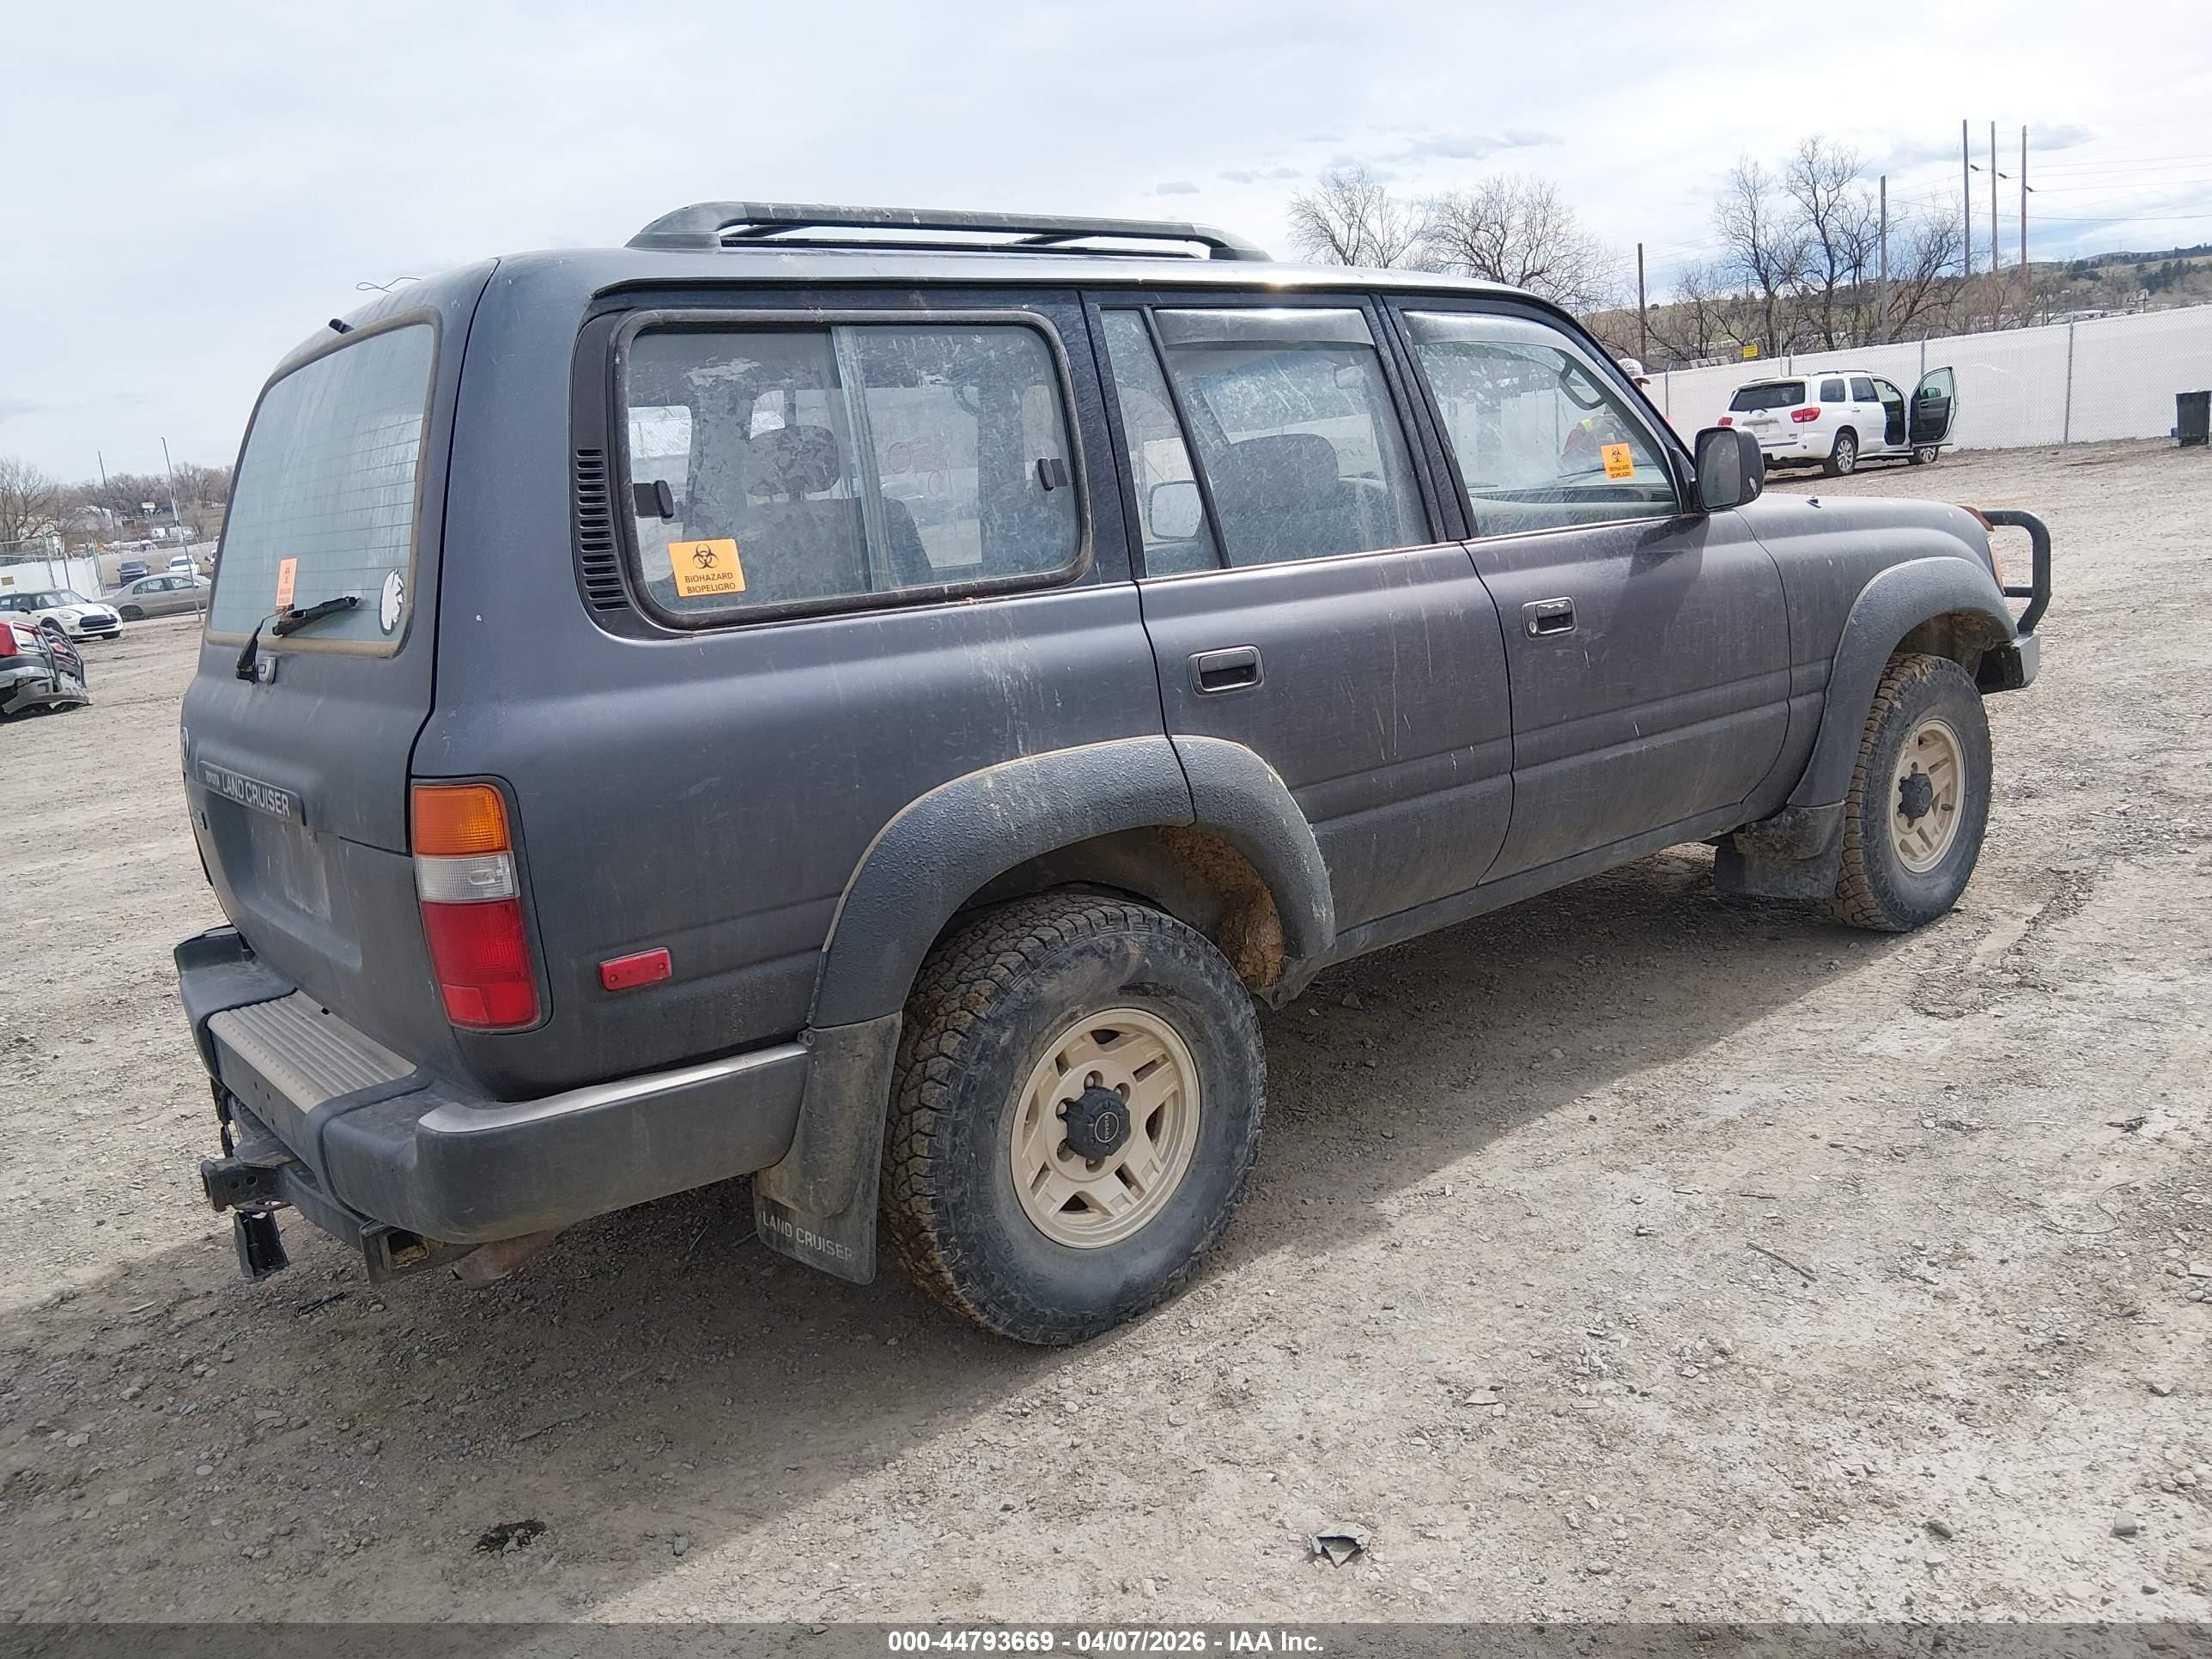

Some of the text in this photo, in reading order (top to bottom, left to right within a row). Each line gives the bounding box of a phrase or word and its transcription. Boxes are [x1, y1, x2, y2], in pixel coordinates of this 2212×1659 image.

[684, 572, 733, 583] BIOHAZARD
[687, 582, 736, 594] BIOPELIGRO
[222, 772, 245, 799] LAND
[245, 781, 290, 817] CRUISER
[762, 1210, 853, 1261] LAND CRUISER
